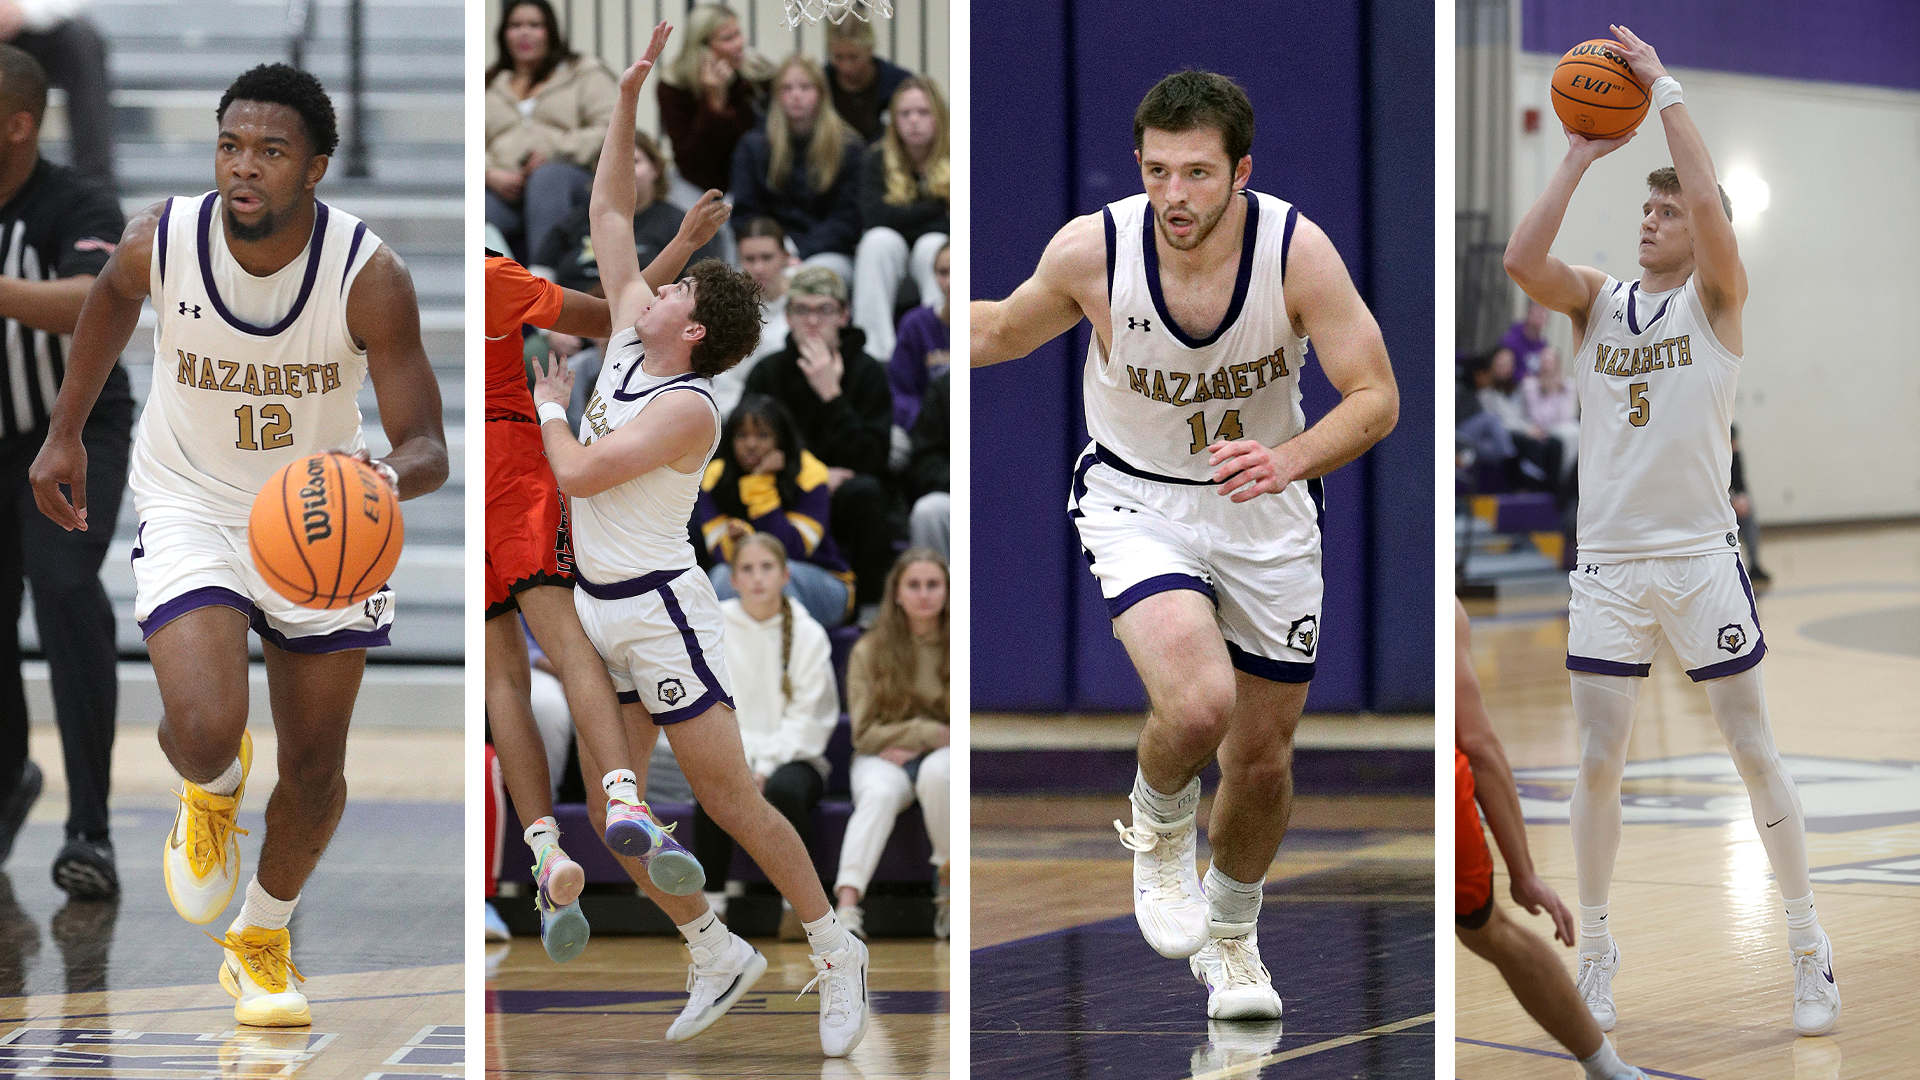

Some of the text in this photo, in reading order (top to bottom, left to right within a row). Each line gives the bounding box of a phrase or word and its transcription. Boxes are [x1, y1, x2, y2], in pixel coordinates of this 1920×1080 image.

[1571, 74, 1612, 95] EVO
[177, 348, 341, 398] NAZARETH
[1127, 347, 1289, 407] NAZARETH
[1594, 335, 1692, 377] NAZARETH
[234, 403, 293, 450] 12
[1628, 382, 1650, 427] 5
[1186, 409, 1244, 455] 14
[299, 456, 332, 545] Wilson
